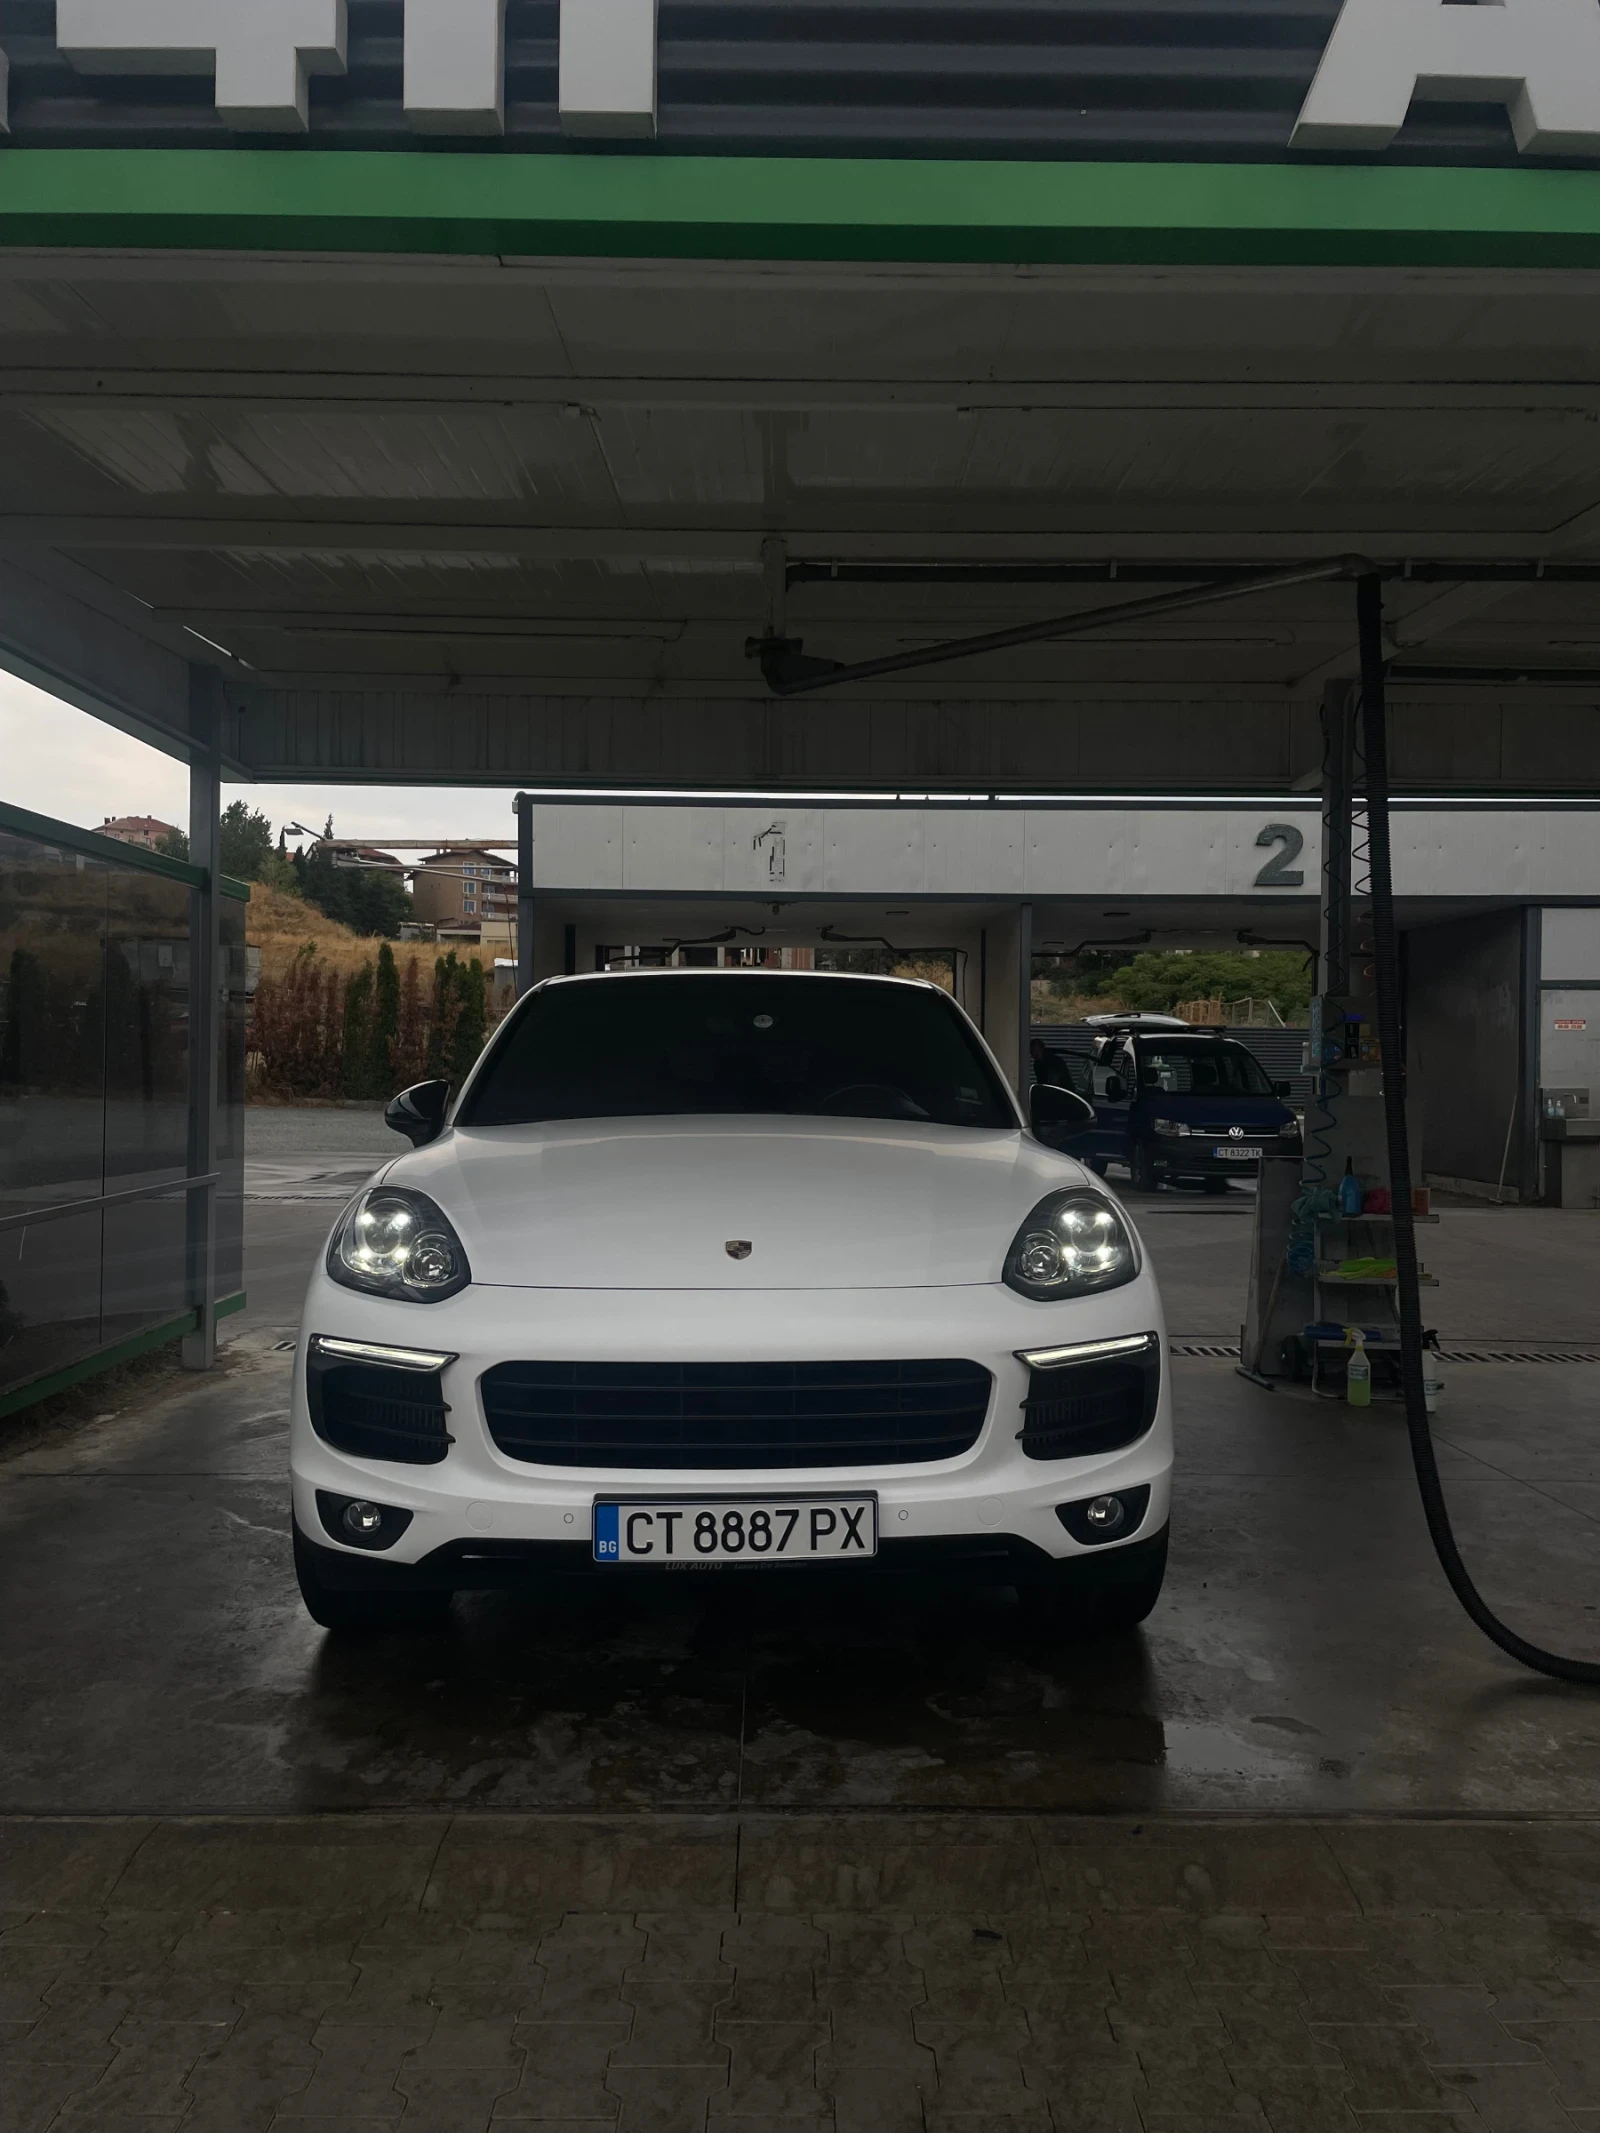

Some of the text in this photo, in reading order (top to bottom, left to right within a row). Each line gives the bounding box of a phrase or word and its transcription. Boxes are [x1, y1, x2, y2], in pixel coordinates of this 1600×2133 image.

[1254, 824, 1304, 886] 2
[1218, 1148, 1261, 1157] CT 8322 TK
[626, 1506, 865, 1555] CT 8887 PX
[599, 1540, 617, 1553] BG
[665, 1562, 723, 1570] LUX AUTO
